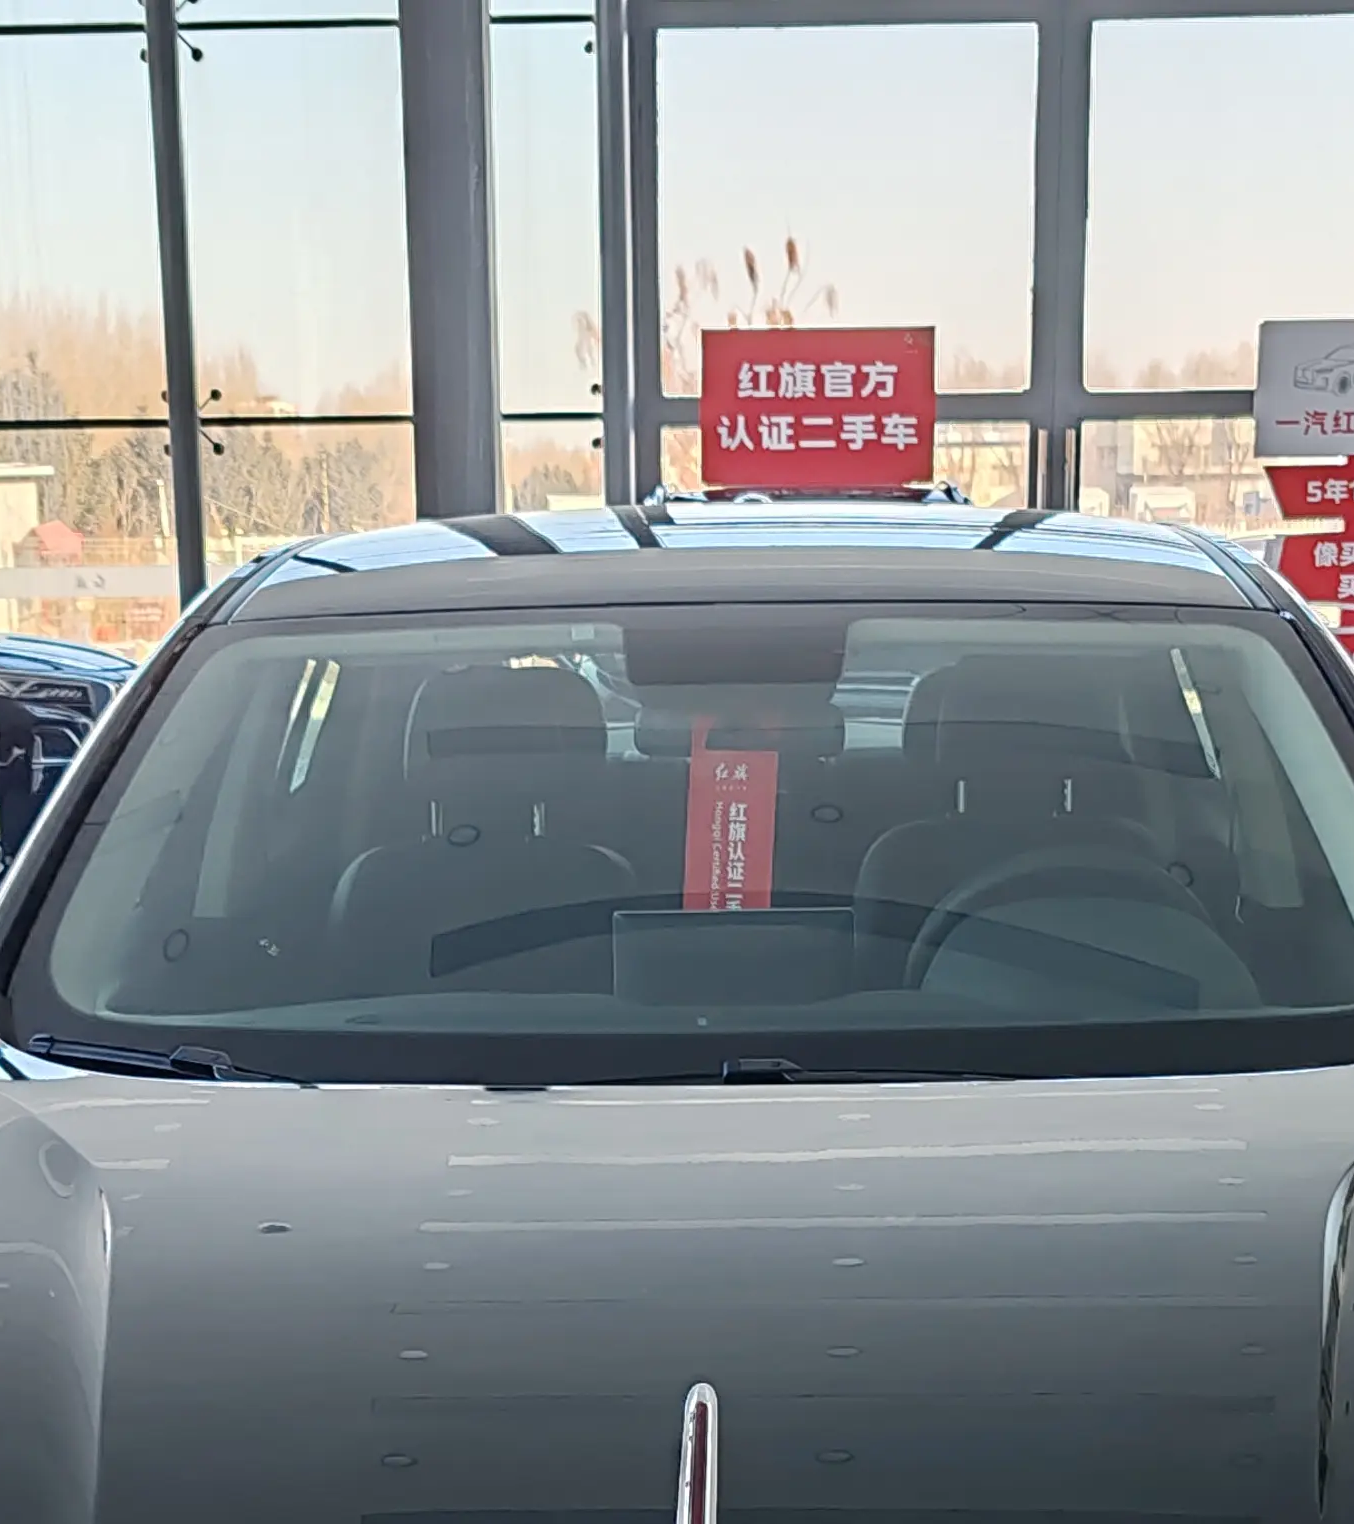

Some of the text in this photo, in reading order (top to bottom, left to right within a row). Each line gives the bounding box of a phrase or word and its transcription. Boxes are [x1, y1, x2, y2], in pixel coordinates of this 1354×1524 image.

[737, 360, 898, 398] 红旗官方
[717, 413, 918, 451] 认证二手车
